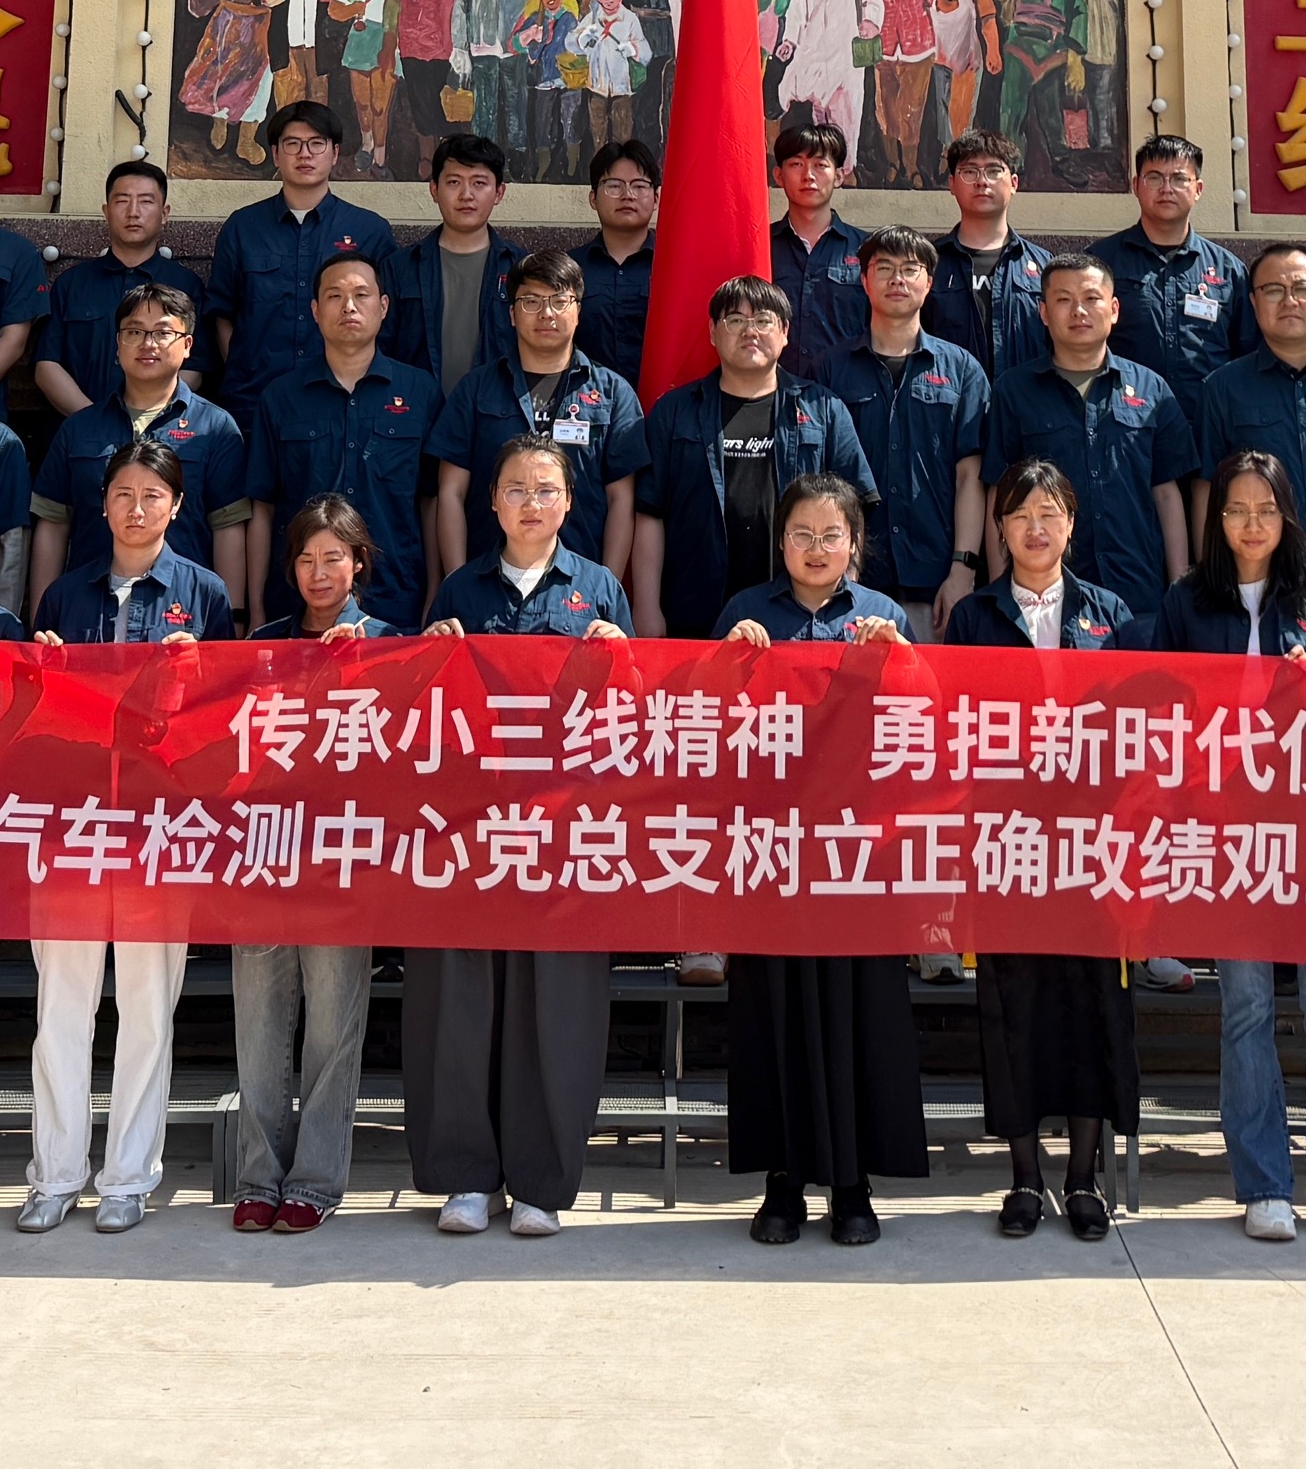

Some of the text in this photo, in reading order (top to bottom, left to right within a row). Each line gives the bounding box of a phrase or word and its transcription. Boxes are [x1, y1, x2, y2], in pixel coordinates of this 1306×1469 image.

[227, 686, 805, 780] 传承小三线精神
